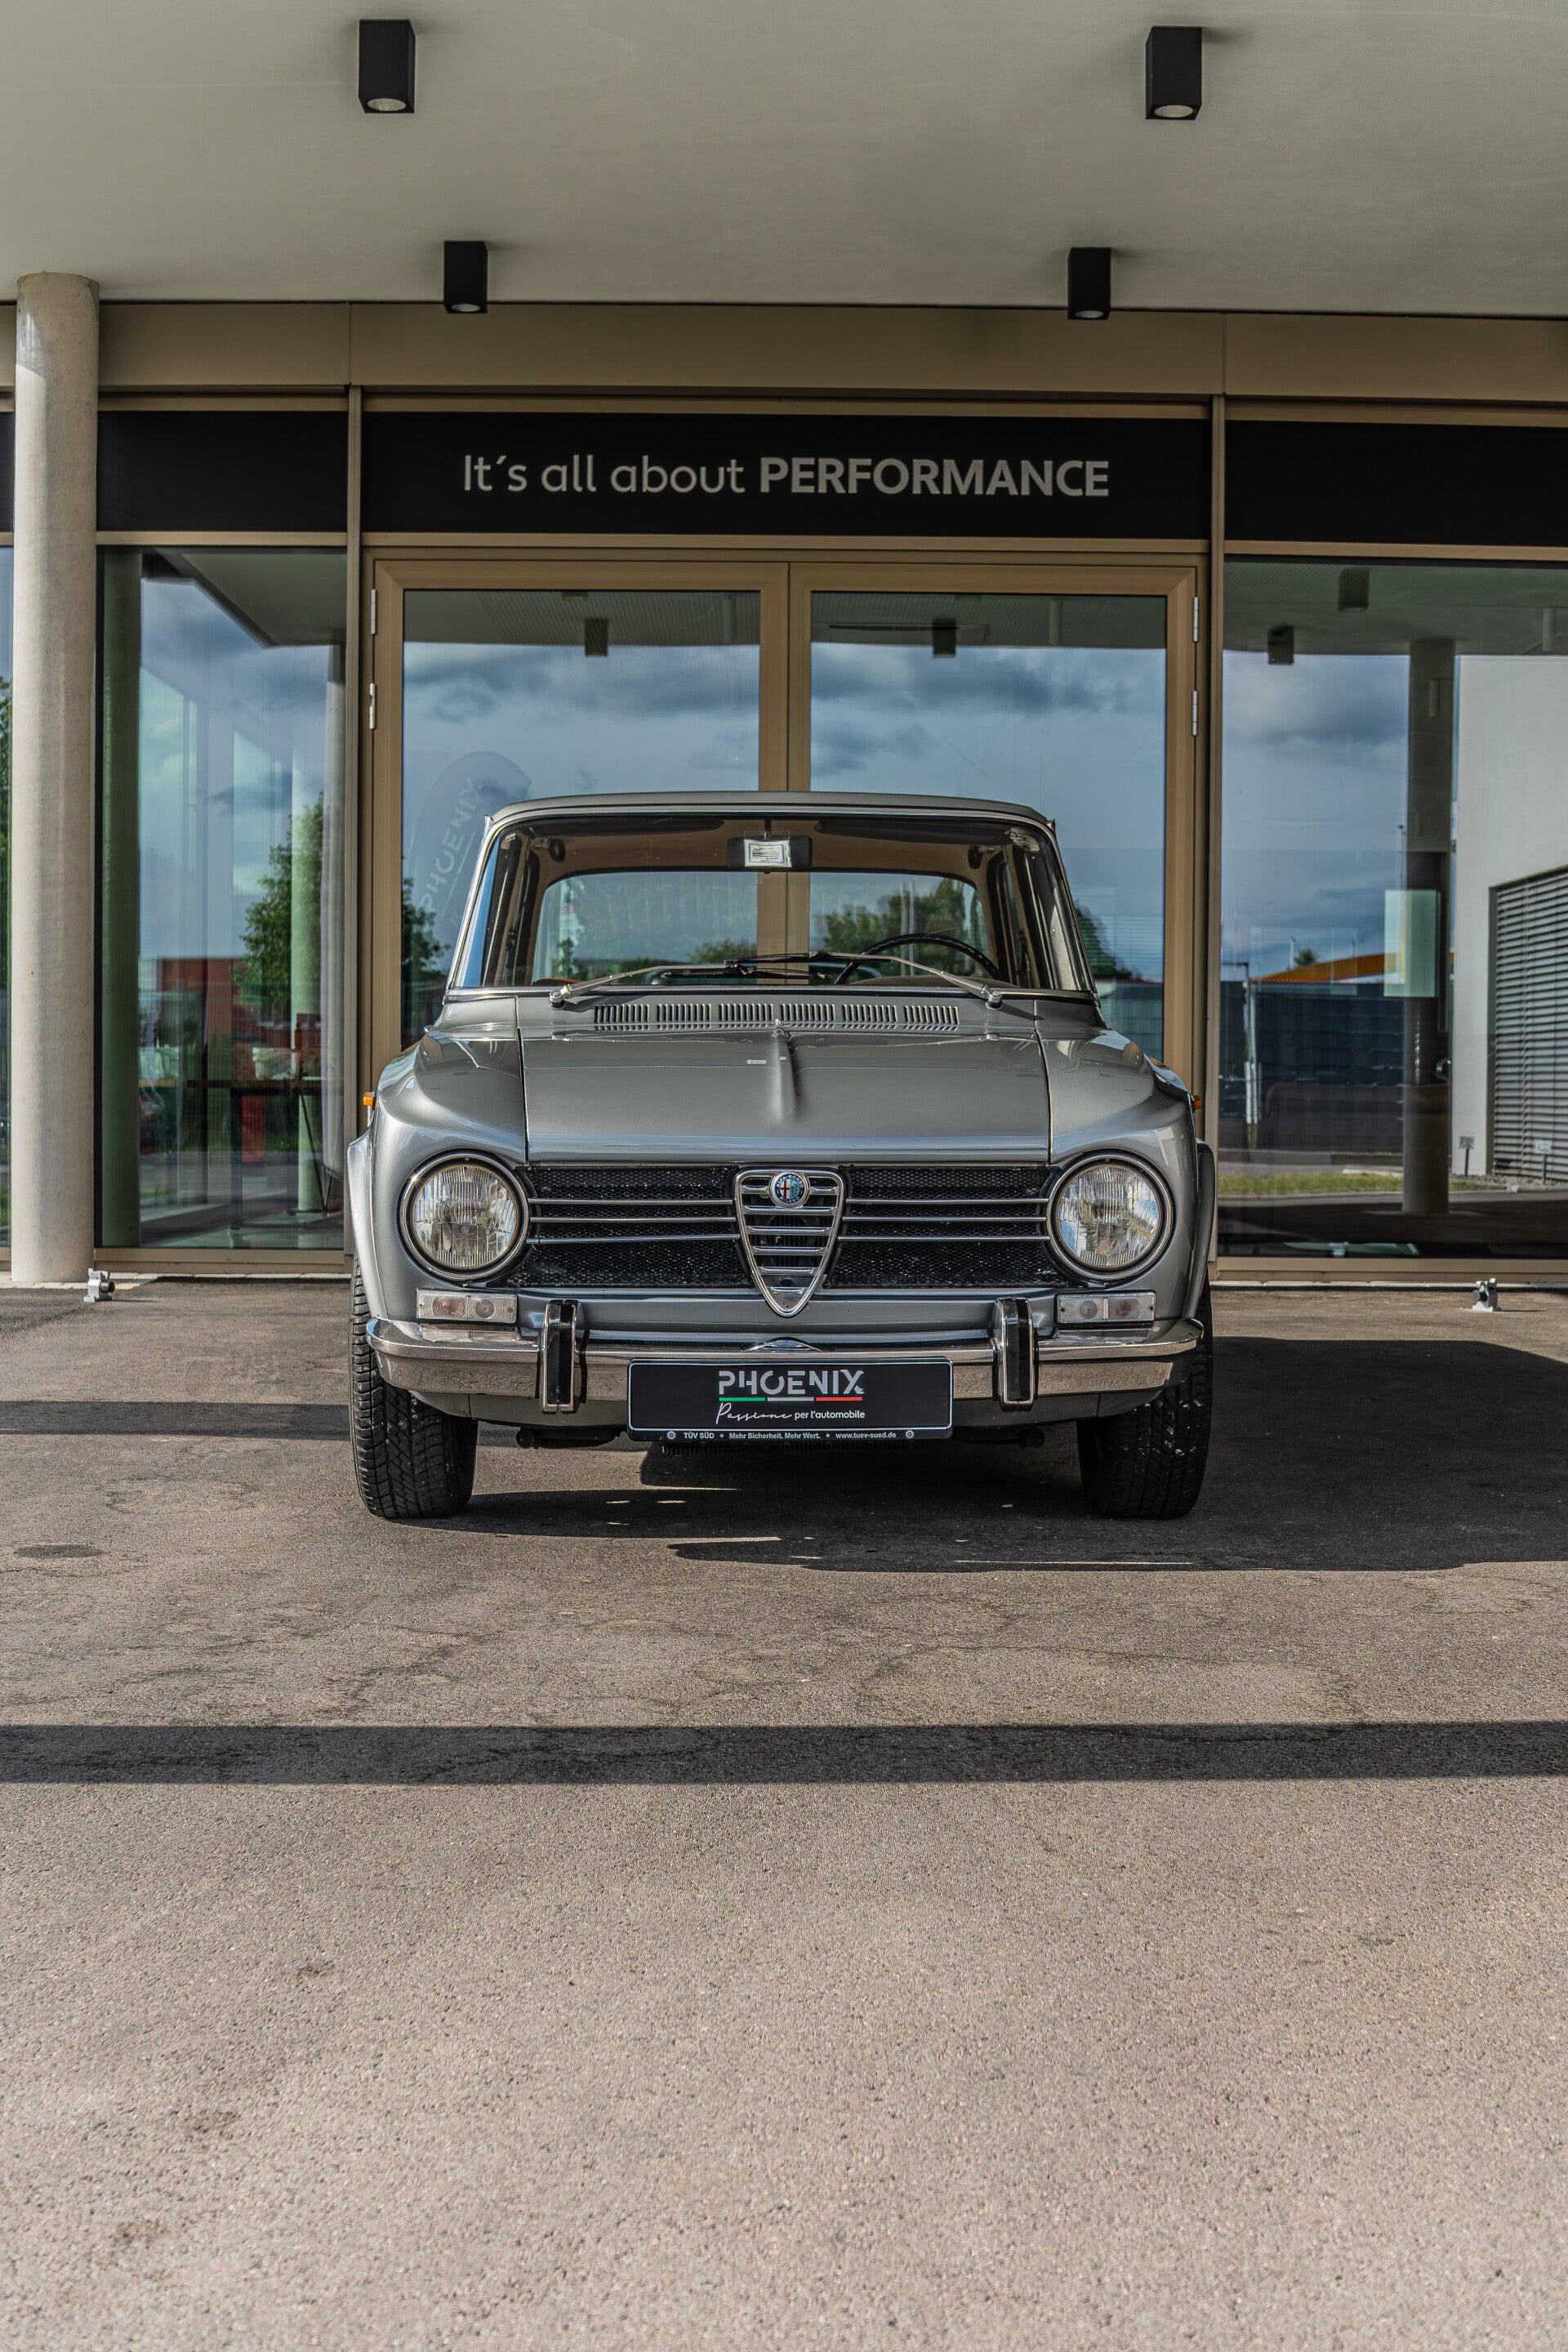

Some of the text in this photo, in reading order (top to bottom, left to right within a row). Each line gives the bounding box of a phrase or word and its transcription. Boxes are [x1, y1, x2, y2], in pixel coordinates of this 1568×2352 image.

[541, 454, 597, 492] all
[610, 454, 746, 493] about
[760, 457, 1109, 497] PERFORMANCE
[719, 1369, 865, 1395] PHOENIX
[715, 1402, 792, 1424] Passione
[794, 1412, 808, 1420] per
[684, 1431, 715, 1439] TÜV SÜD
[835, 1431, 897, 1439] www.tuev-sued.de
